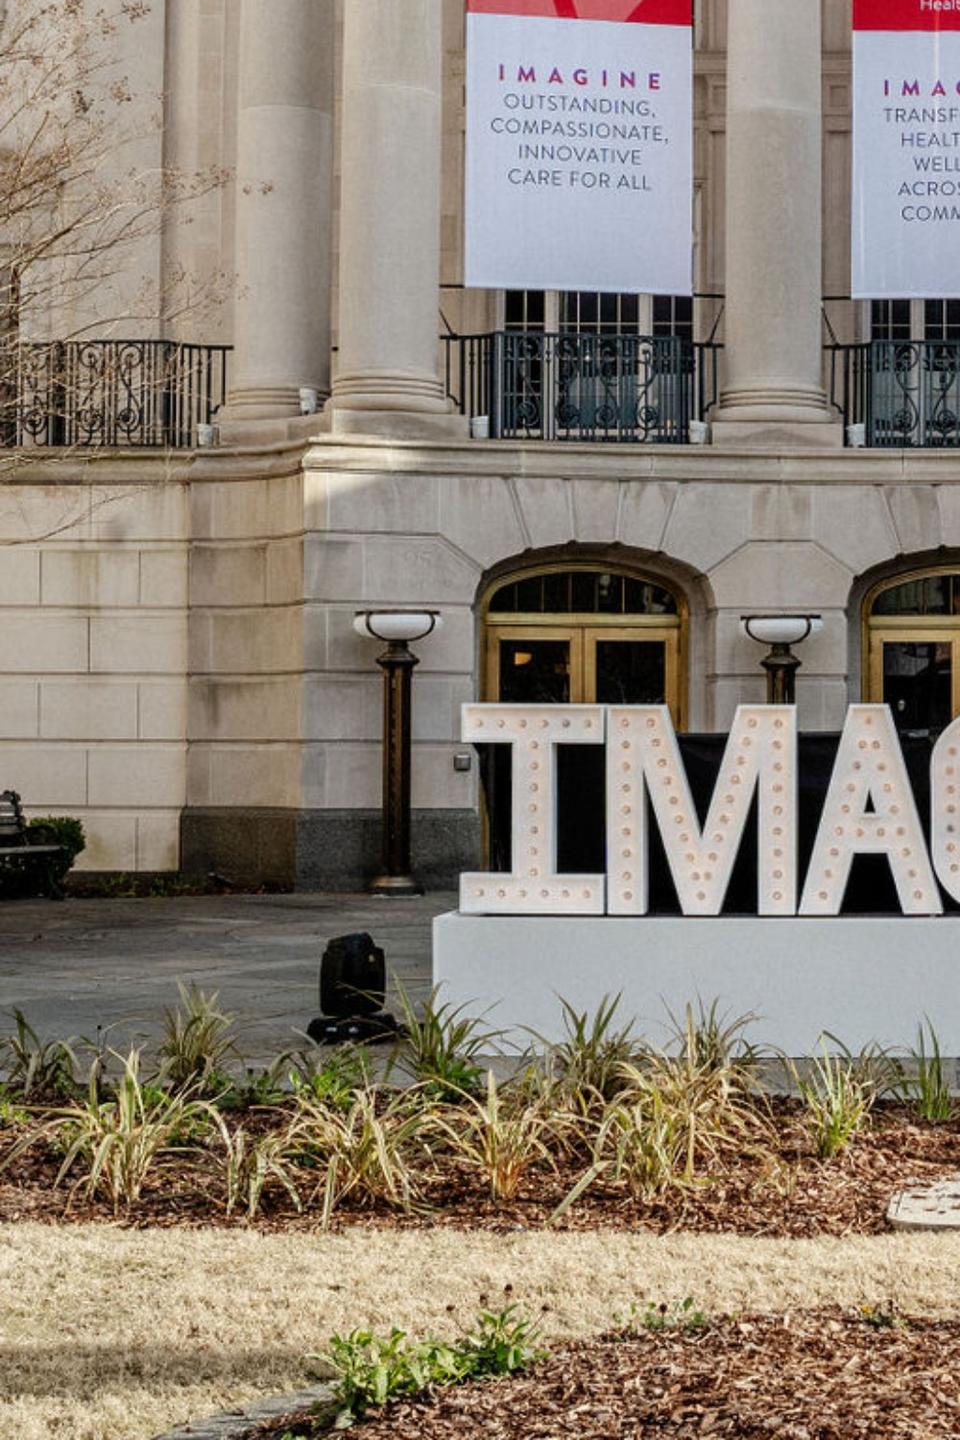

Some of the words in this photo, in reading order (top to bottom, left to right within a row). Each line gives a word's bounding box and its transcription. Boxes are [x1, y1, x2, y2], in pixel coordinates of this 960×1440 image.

[499, 64, 661, 90] IMAGINE
[504, 93, 656, 118] OUTSTANDING,
[491, 118, 669, 144] COMPASSIONATE,
[519, 144, 642, 165] INNOVATIVE
[508, 169, 562, 186] CARE
[570, 170, 611, 188] FOR
[617, 174, 651, 191] ALL
